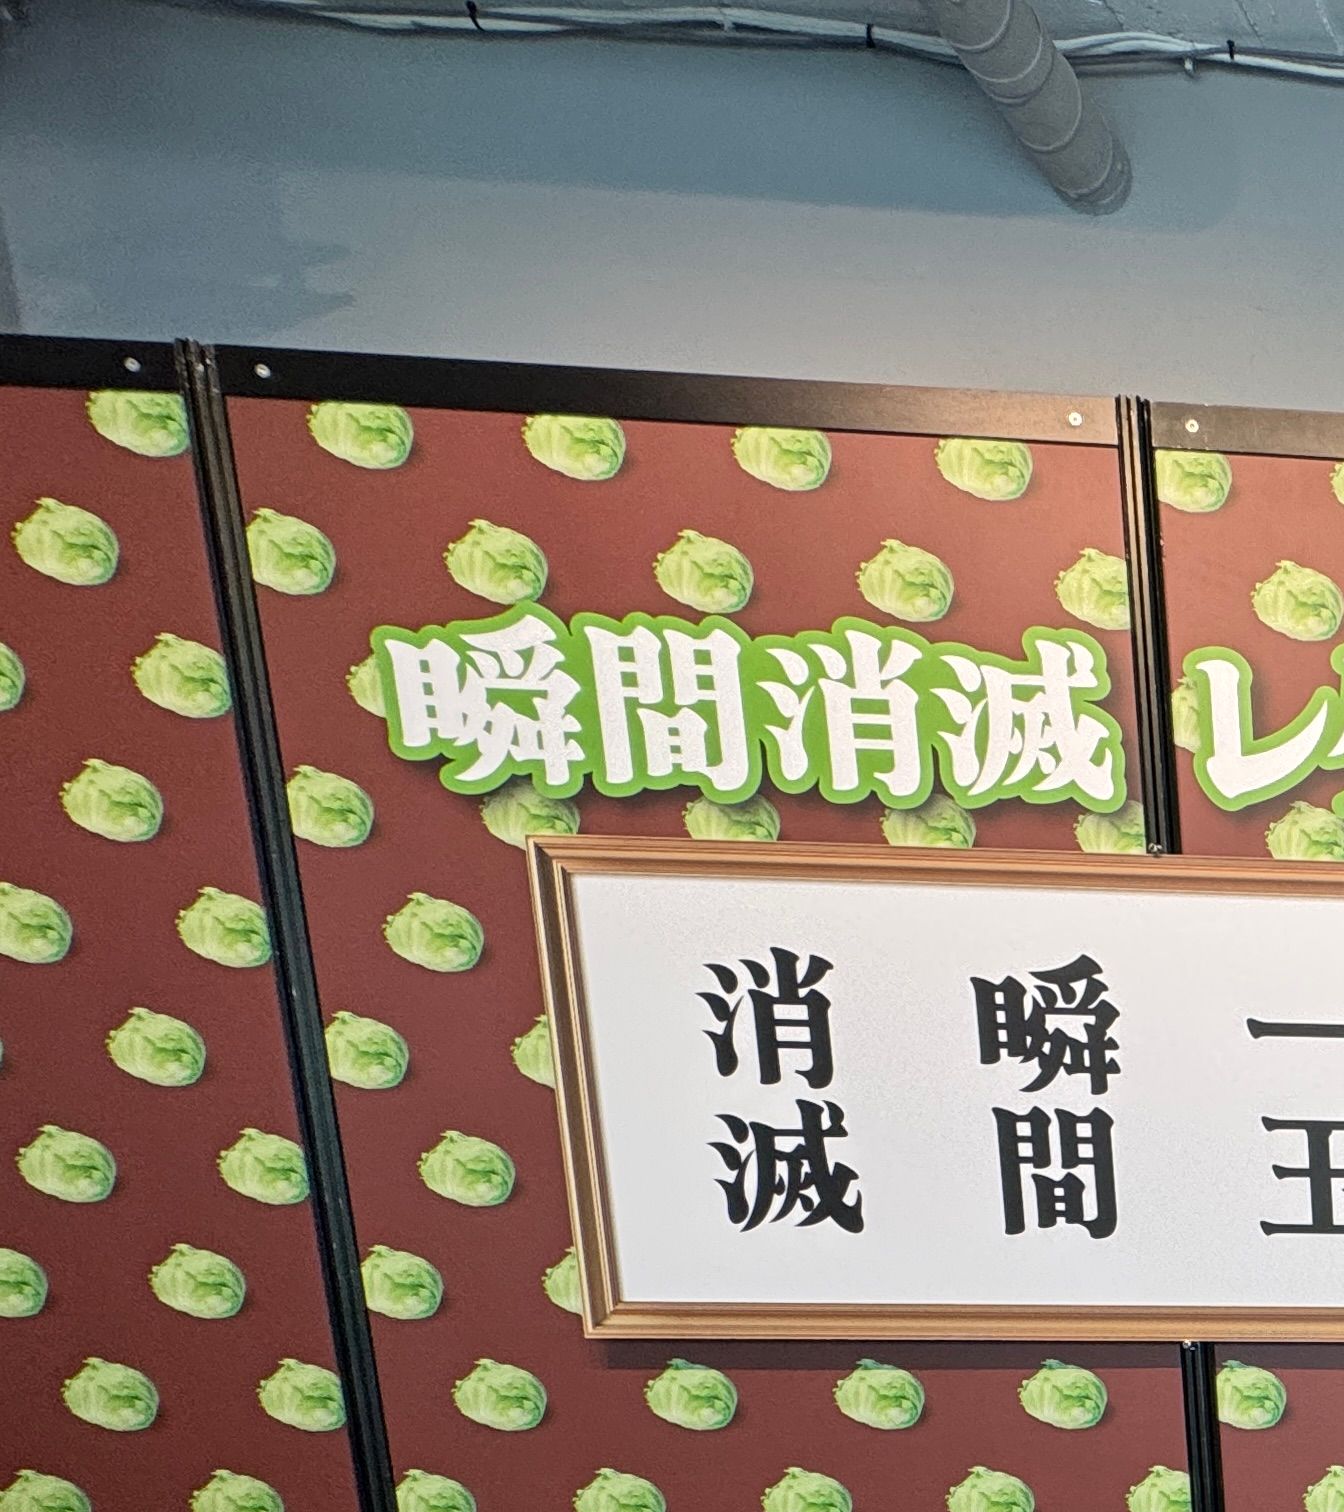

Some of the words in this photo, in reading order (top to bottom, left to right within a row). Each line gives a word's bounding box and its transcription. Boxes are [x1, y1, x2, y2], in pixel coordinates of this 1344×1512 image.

[381, 611, 1117, 802] 瞬間消滅
[695, 946, 864, 1234] 消滅
[969, 953, 1121, 1239] 瞬間
